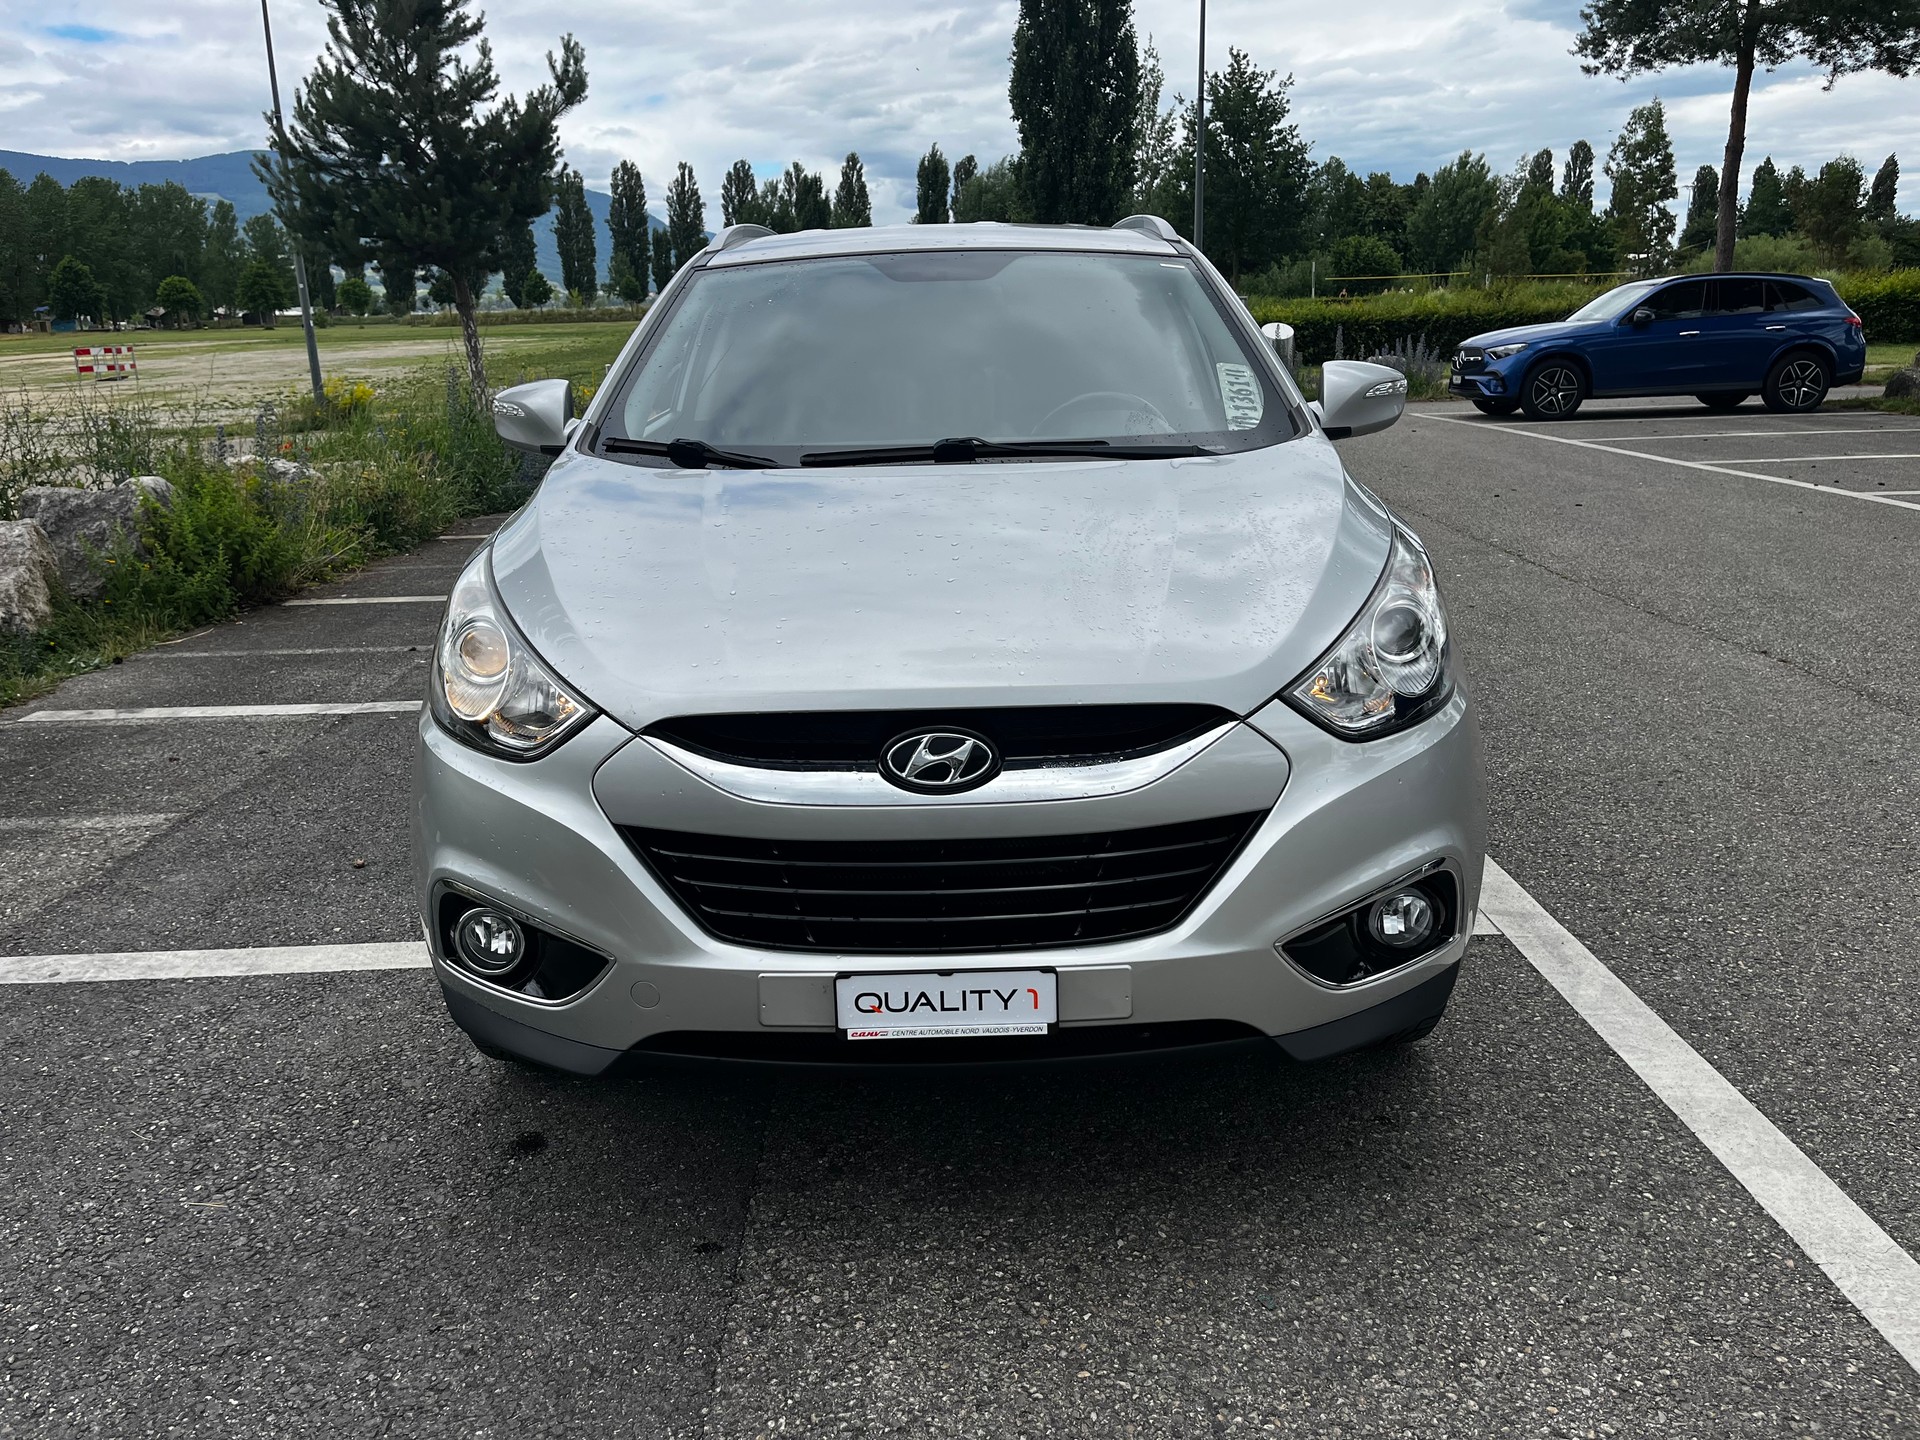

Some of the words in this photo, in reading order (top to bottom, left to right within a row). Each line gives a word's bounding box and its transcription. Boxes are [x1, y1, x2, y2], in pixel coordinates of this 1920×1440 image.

[855, 988, 1018, 1014] QUALITY
[1027, 988, 1039, 1010] 1
[892, 1029, 917, 1037] CENTRE
[919, 1028, 959, 1036] AUTOMOBILE
[961, 1027, 979, 1035] NORD
